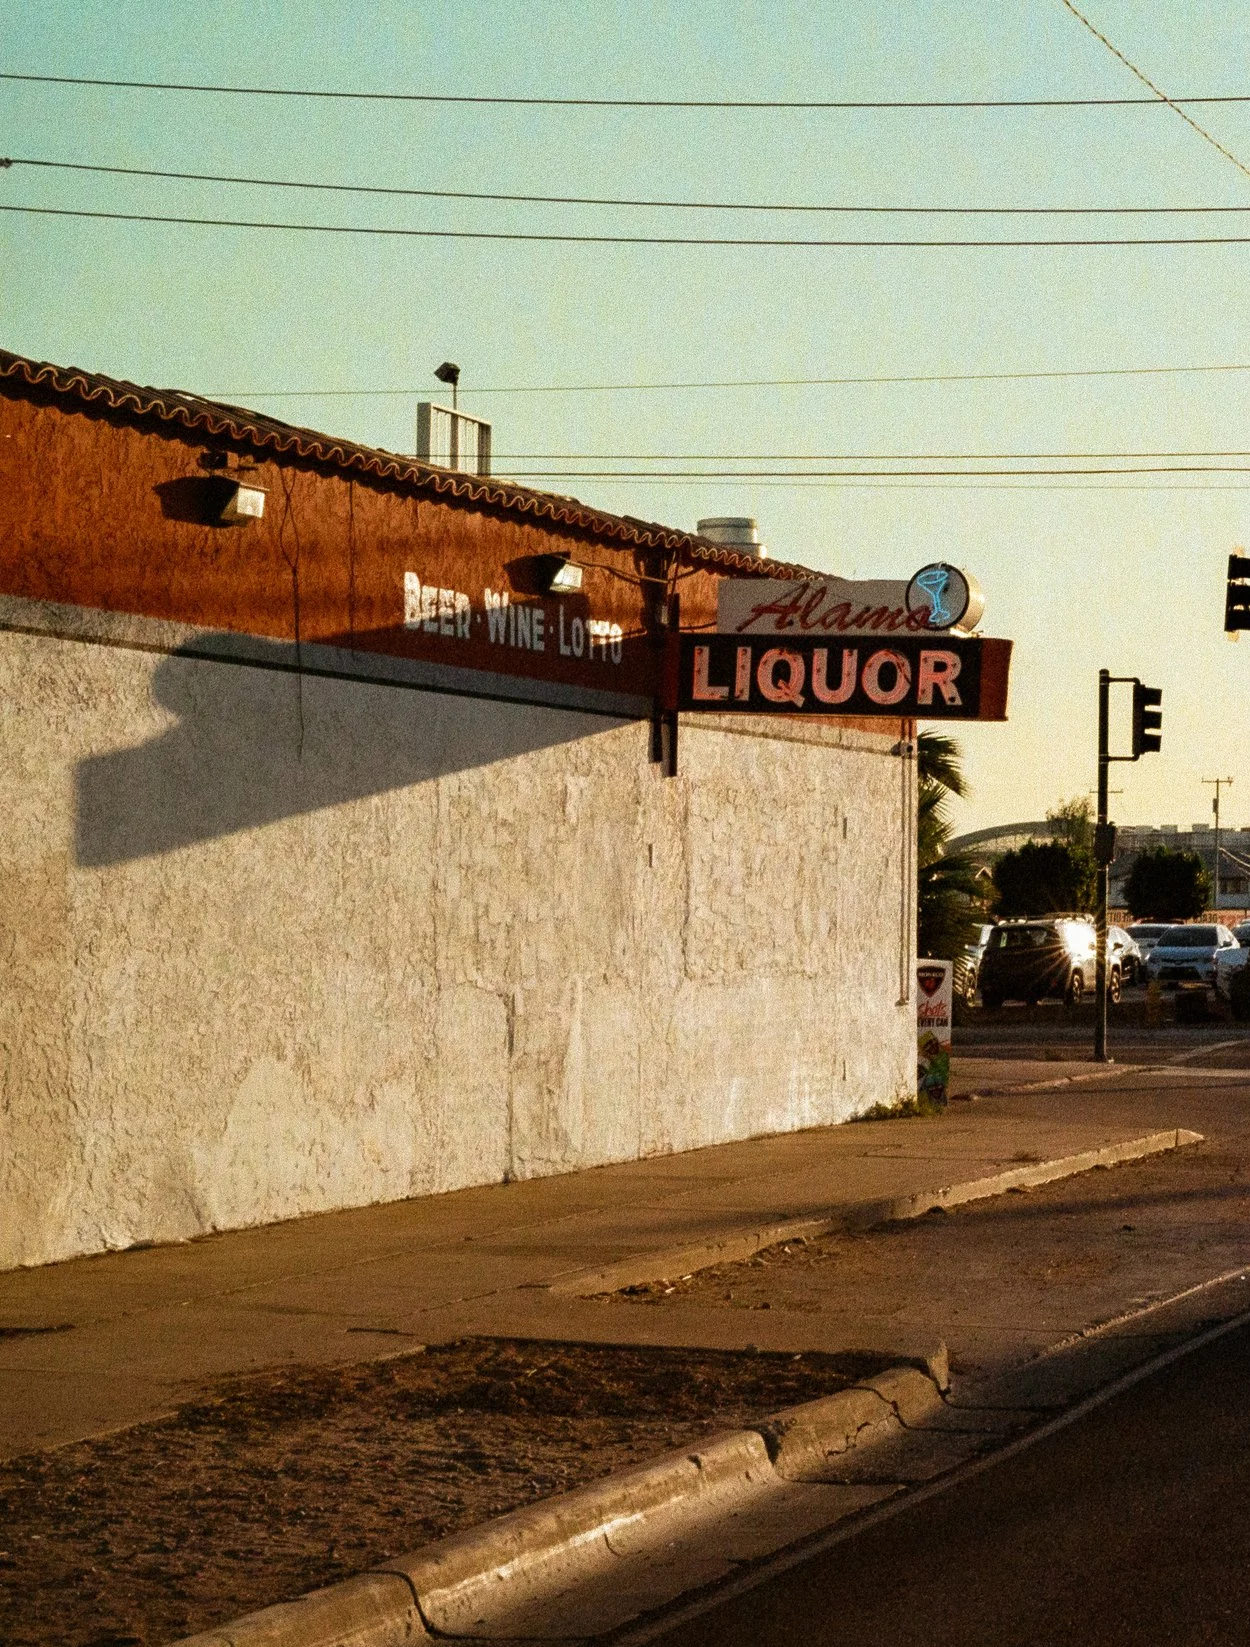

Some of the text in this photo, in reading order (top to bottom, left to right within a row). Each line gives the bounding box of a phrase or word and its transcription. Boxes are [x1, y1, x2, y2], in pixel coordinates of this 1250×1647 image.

[404, 571, 470, 639] BEER
[484, 587, 545, 651] WINE
[735, 581, 934, 632] Alamo
[690, 645, 964, 708] LIQUOR
